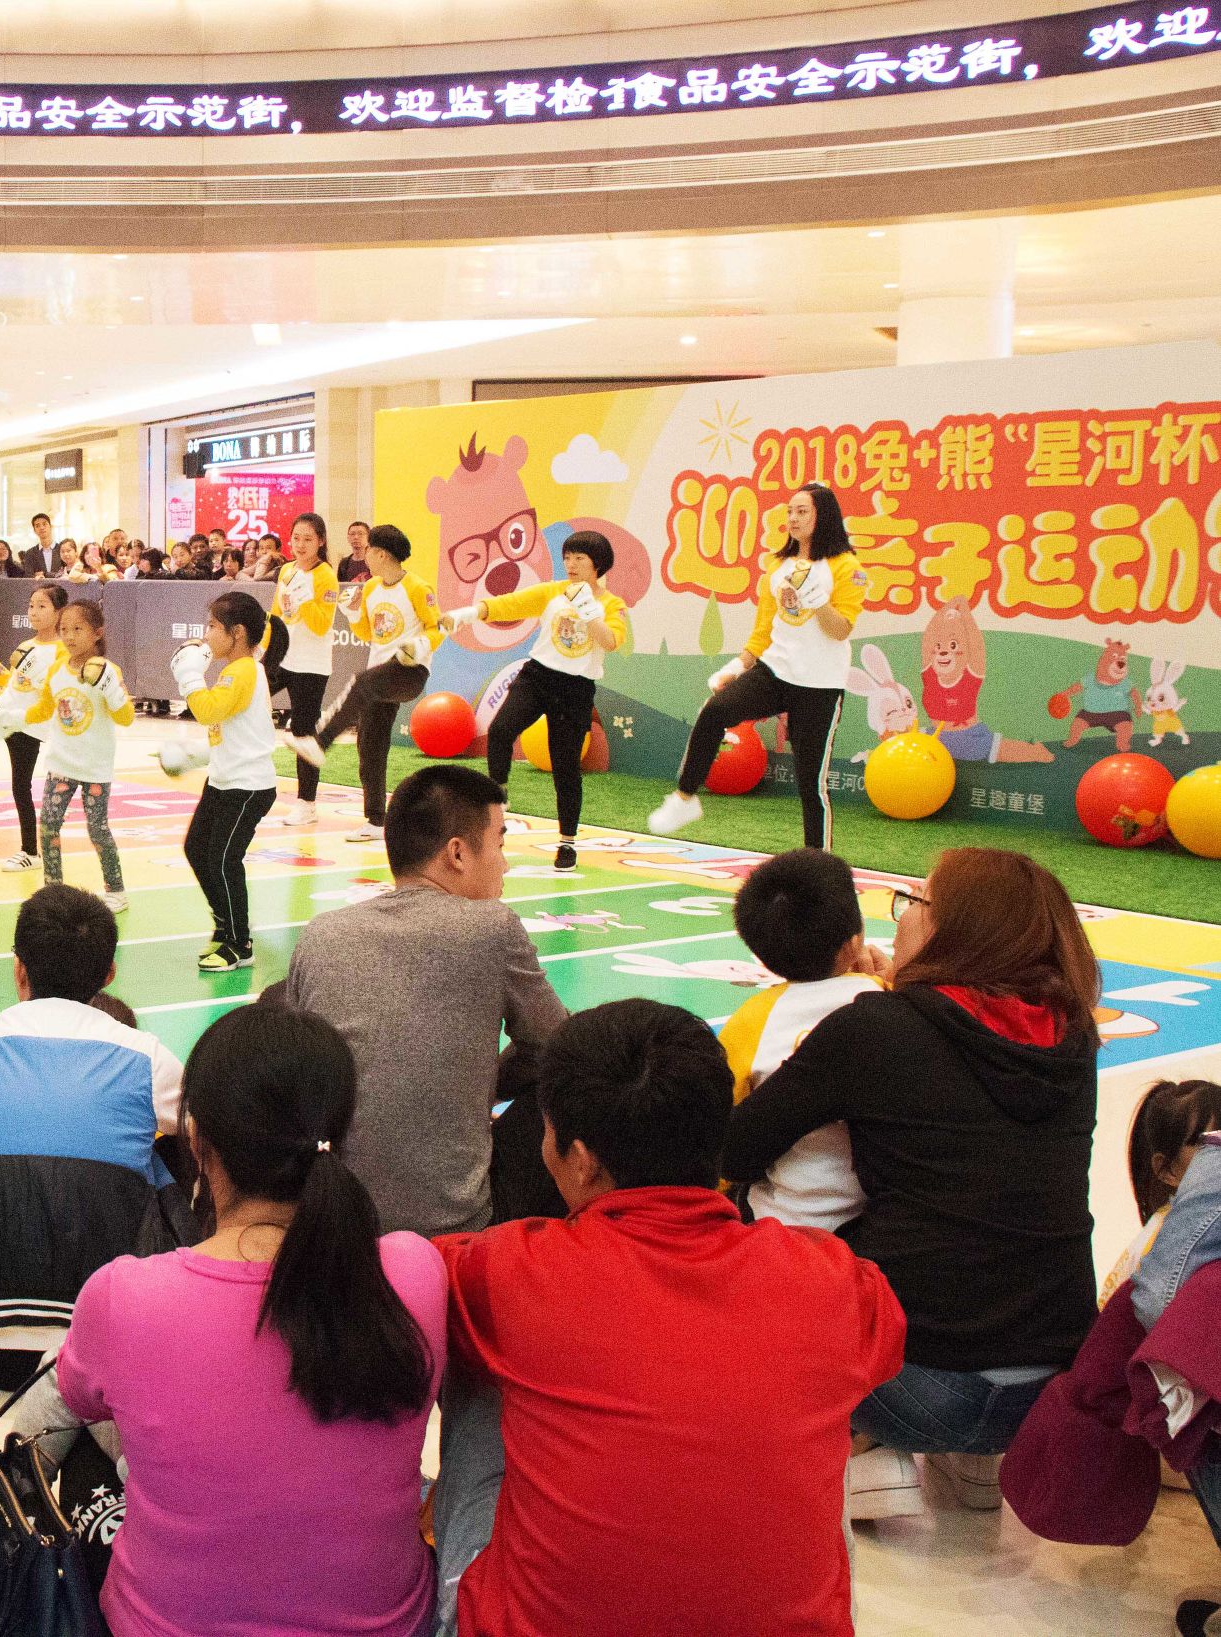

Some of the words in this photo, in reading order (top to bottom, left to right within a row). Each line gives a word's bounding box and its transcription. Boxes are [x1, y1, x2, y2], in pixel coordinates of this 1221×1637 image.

[1083, 7, 1221, 60] 欢迎
[227, 509, 269, 541] 25
[171, 622, 205, 640] 星河
